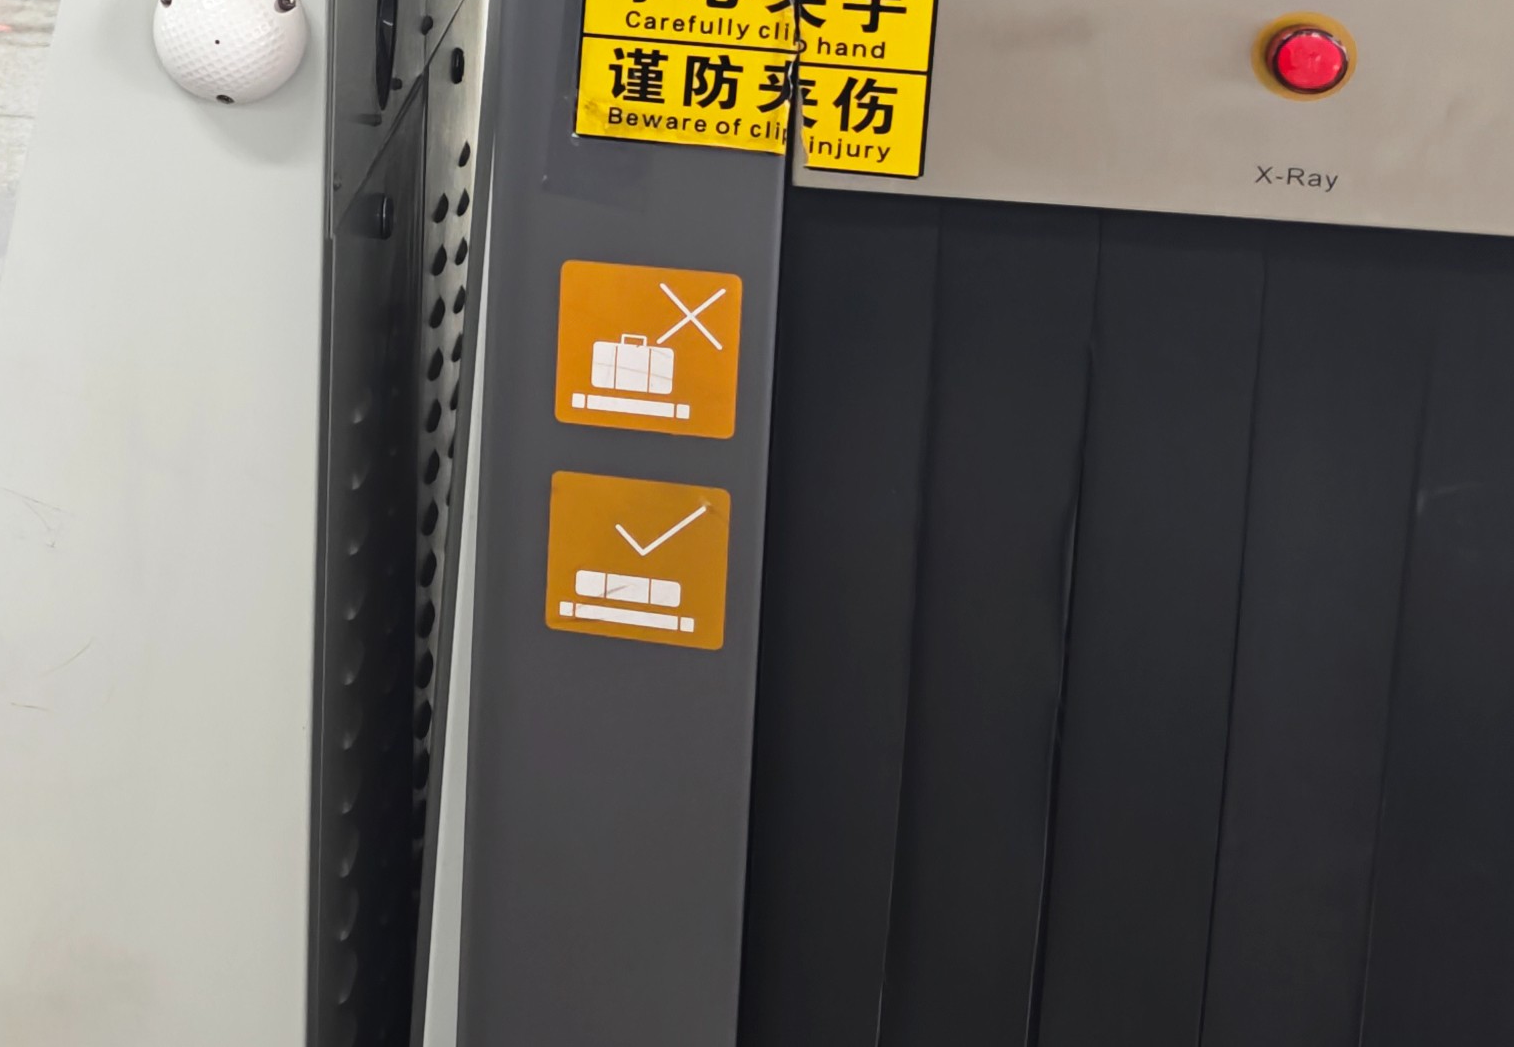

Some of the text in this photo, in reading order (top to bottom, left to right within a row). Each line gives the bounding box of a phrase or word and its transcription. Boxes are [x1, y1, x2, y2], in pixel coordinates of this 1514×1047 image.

[625, 10, 750, 41] Carefully
[817, 36, 886, 59] hand
[608, 47, 899, 135] 谨防夹伤
[607, 106, 708, 134] Beware
[715, 118, 742, 136] of
[808, 136, 892, 164] injury
[1255, 165, 1339, 193] X-Ray
